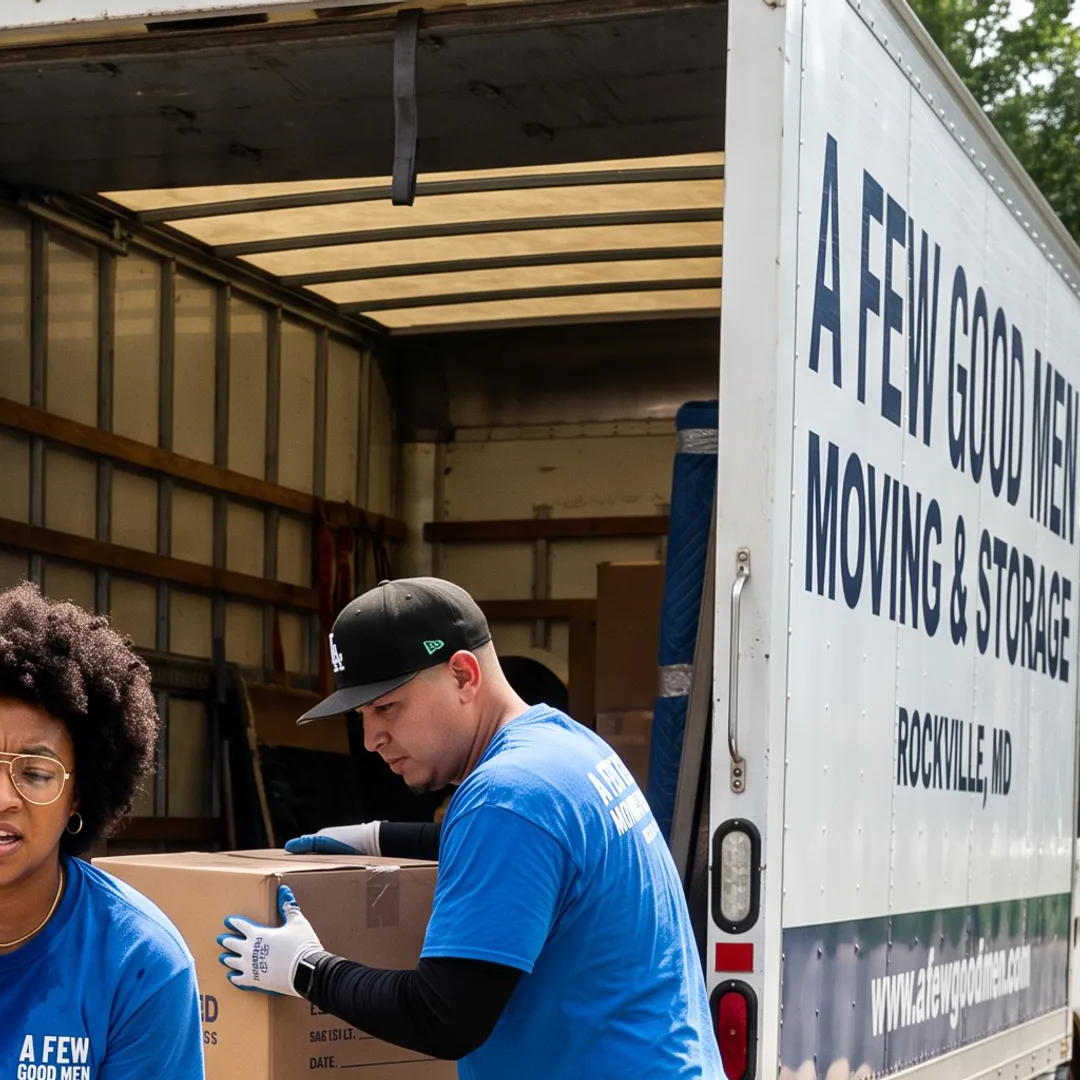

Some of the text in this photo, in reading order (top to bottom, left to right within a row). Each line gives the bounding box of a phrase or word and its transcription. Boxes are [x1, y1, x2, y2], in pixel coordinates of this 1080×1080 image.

[809, 132, 1079, 546] A FEW GOOD MEN
[805, 430, 1071, 683] MOVING & STORAGE
[896, 706, 1012, 810] ROCKVILLE, MD
[871, 937, 1031, 1037] www.afewgoodmen.com
[19, 1034, 90, 1064] A FEW
